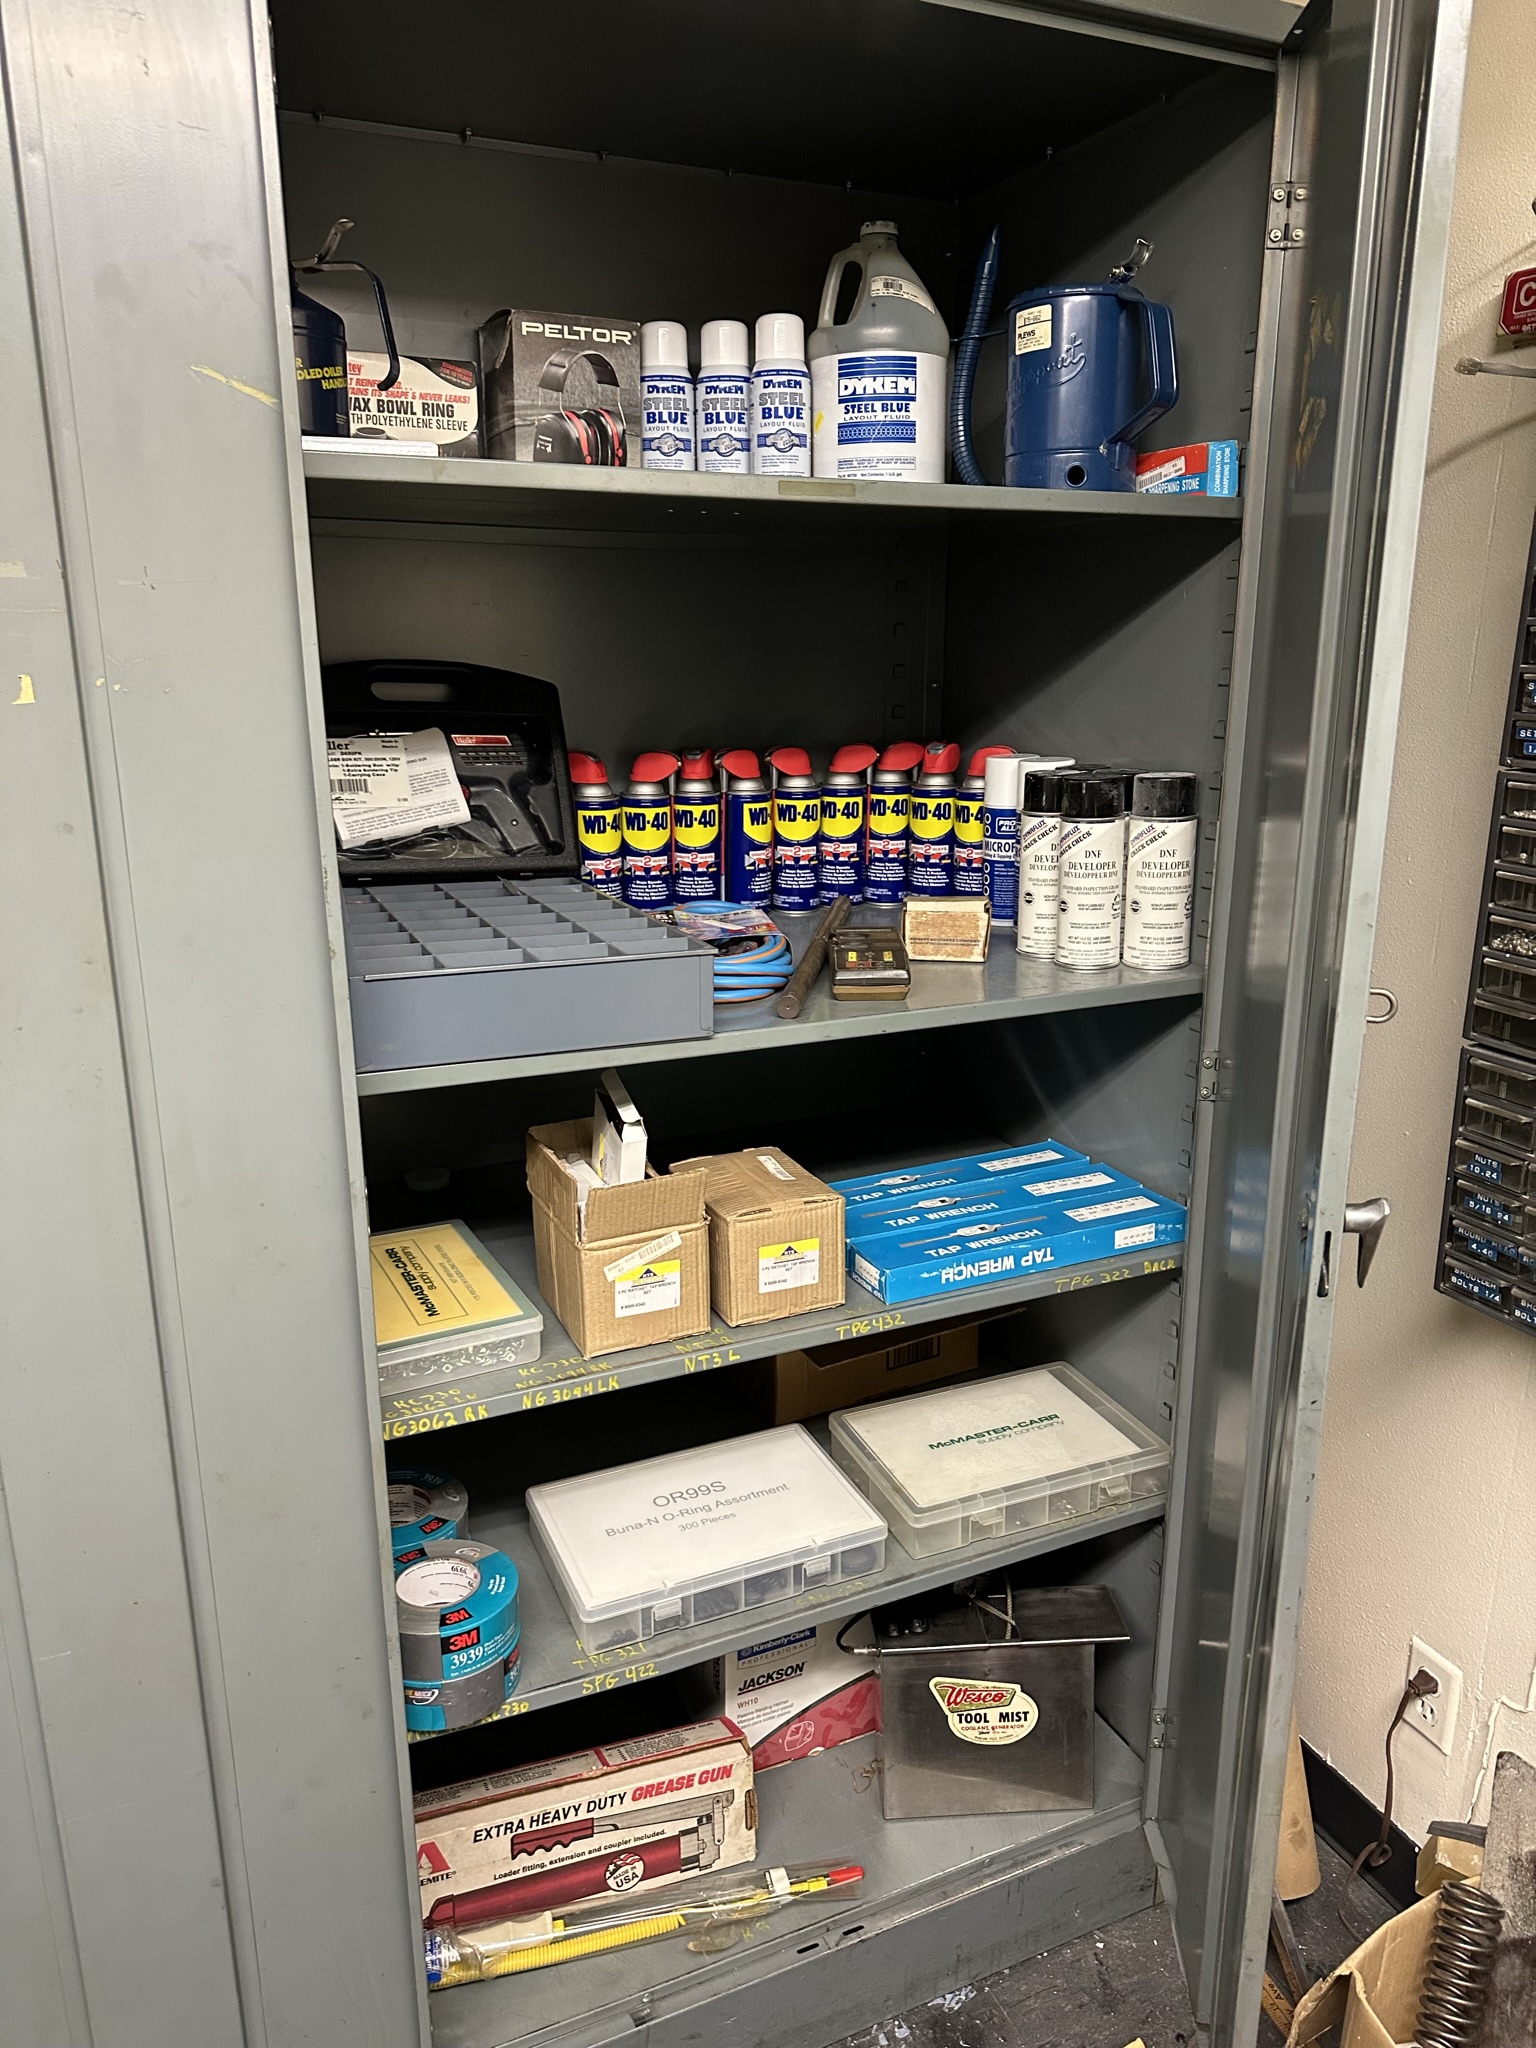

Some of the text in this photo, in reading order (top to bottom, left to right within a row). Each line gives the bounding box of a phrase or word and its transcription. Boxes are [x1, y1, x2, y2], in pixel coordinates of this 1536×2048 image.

[522, 322, 632, 345] PELTOR
[1017, 330, 1036, 341] PLEWS
[647, 384, 686, 395] DYKEM
[705, 384, 744, 395] DYKEM
[762, 379, 803, 390] DYKEM
[838, 376, 916, 397] DYKEM
[371, 389, 471, 404] ITS SHAPE NEVER LEAKS!
[643, 397, 690, 412] STEEL
[702, 397, 749, 412] STEEL
[758, 392, 806, 406] STEEL
[377, 400, 417, 416] BOWL
[422, 402, 455, 418] RING
[762, 406, 804, 420] BLUE
[844, 403, 911, 415] STEEL BLUE
[366, 415, 468, 432] POLYETHYLENE SLEEVE
[646, 412, 688, 425] BLUE
[704, 412, 746, 425] BLUE
[760, 420, 806, 428] LAYOUT FLUID
[844, 414, 878, 422] LAYOUT
[1214, 450, 1223, 493] COMBINATION
[1222, 464, 1230, 495] SHARPENING
[1148, 478, 1200, 494] SHARPENING STONE
[776, 803, 819, 823] WD-40
[822, 800, 860, 820] WD-40
[870, 798, 909, 817] WD-40
[912, 802, 952, 821] WD-40
[956, 804, 984, 824] WD-4
[624, 812, 668, 832] WD-40
[674, 808, 717, 829] WD-40
[1038, 825, 1059, 843] CHECK
[1071, 830, 1093, 847] CHECK
[1146, 830, 1168, 847] CHECK
[765, 848, 772, 859] 2
[794, 846, 801, 856] 2
[833, 842, 841, 853] 2
[882, 840, 891, 850] 2
[924, 844, 932, 854] 2
[966, 848, 974, 858] 2
[1160, 849, 1178, 858] DNF
[644, 856, 652, 867] 2
[690, 852, 699, 863] 2
[1084, 850, 1102, 859] DNF
[604, 860, 612, 870] 2
[1068, 861, 1117, 871] DEVELOPER
[1142, 861, 1190, 871] DEVELOPER
[1108, 870, 1119, 878] DNF
[1182, 870, 1192, 878] DNF
[1474, 1154, 1498, 1168] NUTS
[1470, 1164, 1498, 1180] 10.24
[850, 1178, 958, 1202] TAP WRENCH
[884, 1203, 1000, 1227] TAP WRENCH
[924, 1228, 1043, 1258] TAP WRENCH
[400, 1246, 437, 1291] supply company
[941, 1248, 1055, 1284] TAP WRENCH
[384, 1248, 441, 1317] McMASTER-CARR
[1055, 1277, 1094, 1293] TPG
[1100, 1269, 1133, 1283] 322
[1451, 1275, 1501, 1302] BOLTS 1/4
[684, 1352, 723, 1375] NT3
[928, 1413, 1061, 1450] McMASTER-CARR
[976, 1419, 1066, 1446] supply company
[653, 1480, 727, 1508] OR99S
[604, 1483, 790, 1537] Buna-N O-Ring Assortment
[422, 1520, 443, 1533] 3M
[678, 1512, 737, 1532] 300 Pieces
[398, 1550, 422, 1563] 3M
[451, 1565, 469, 1575] 3939
[446, 1609, 470, 1625] 3M
[449, 1630, 479, 1651] 3M
[752, 1630, 811, 1652] Kimberly-Clark
[450, 1646, 483, 1670] 3939
[614, 1642, 647, 1660] 321
[742, 1641, 810, 1667] PROFESSIONAL
[582, 1663, 659, 1695] SPG 422
[738, 1662, 806, 1692] JACKSON
[737, 1697, 759, 1709] WH10
[936, 1685, 1008, 1707] Wesco
[957, 1711, 1030, 1724] TOOL MIST
[473, 1764, 734, 1844] EXTRA HEAVY DUTY GREASE GUN
[494, 1829, 667, 1881] Loader fitting, extension and coupler included.
[612, 1865, 638, 1881] MADE IN
[616, 1872, 640, 1889] USA
